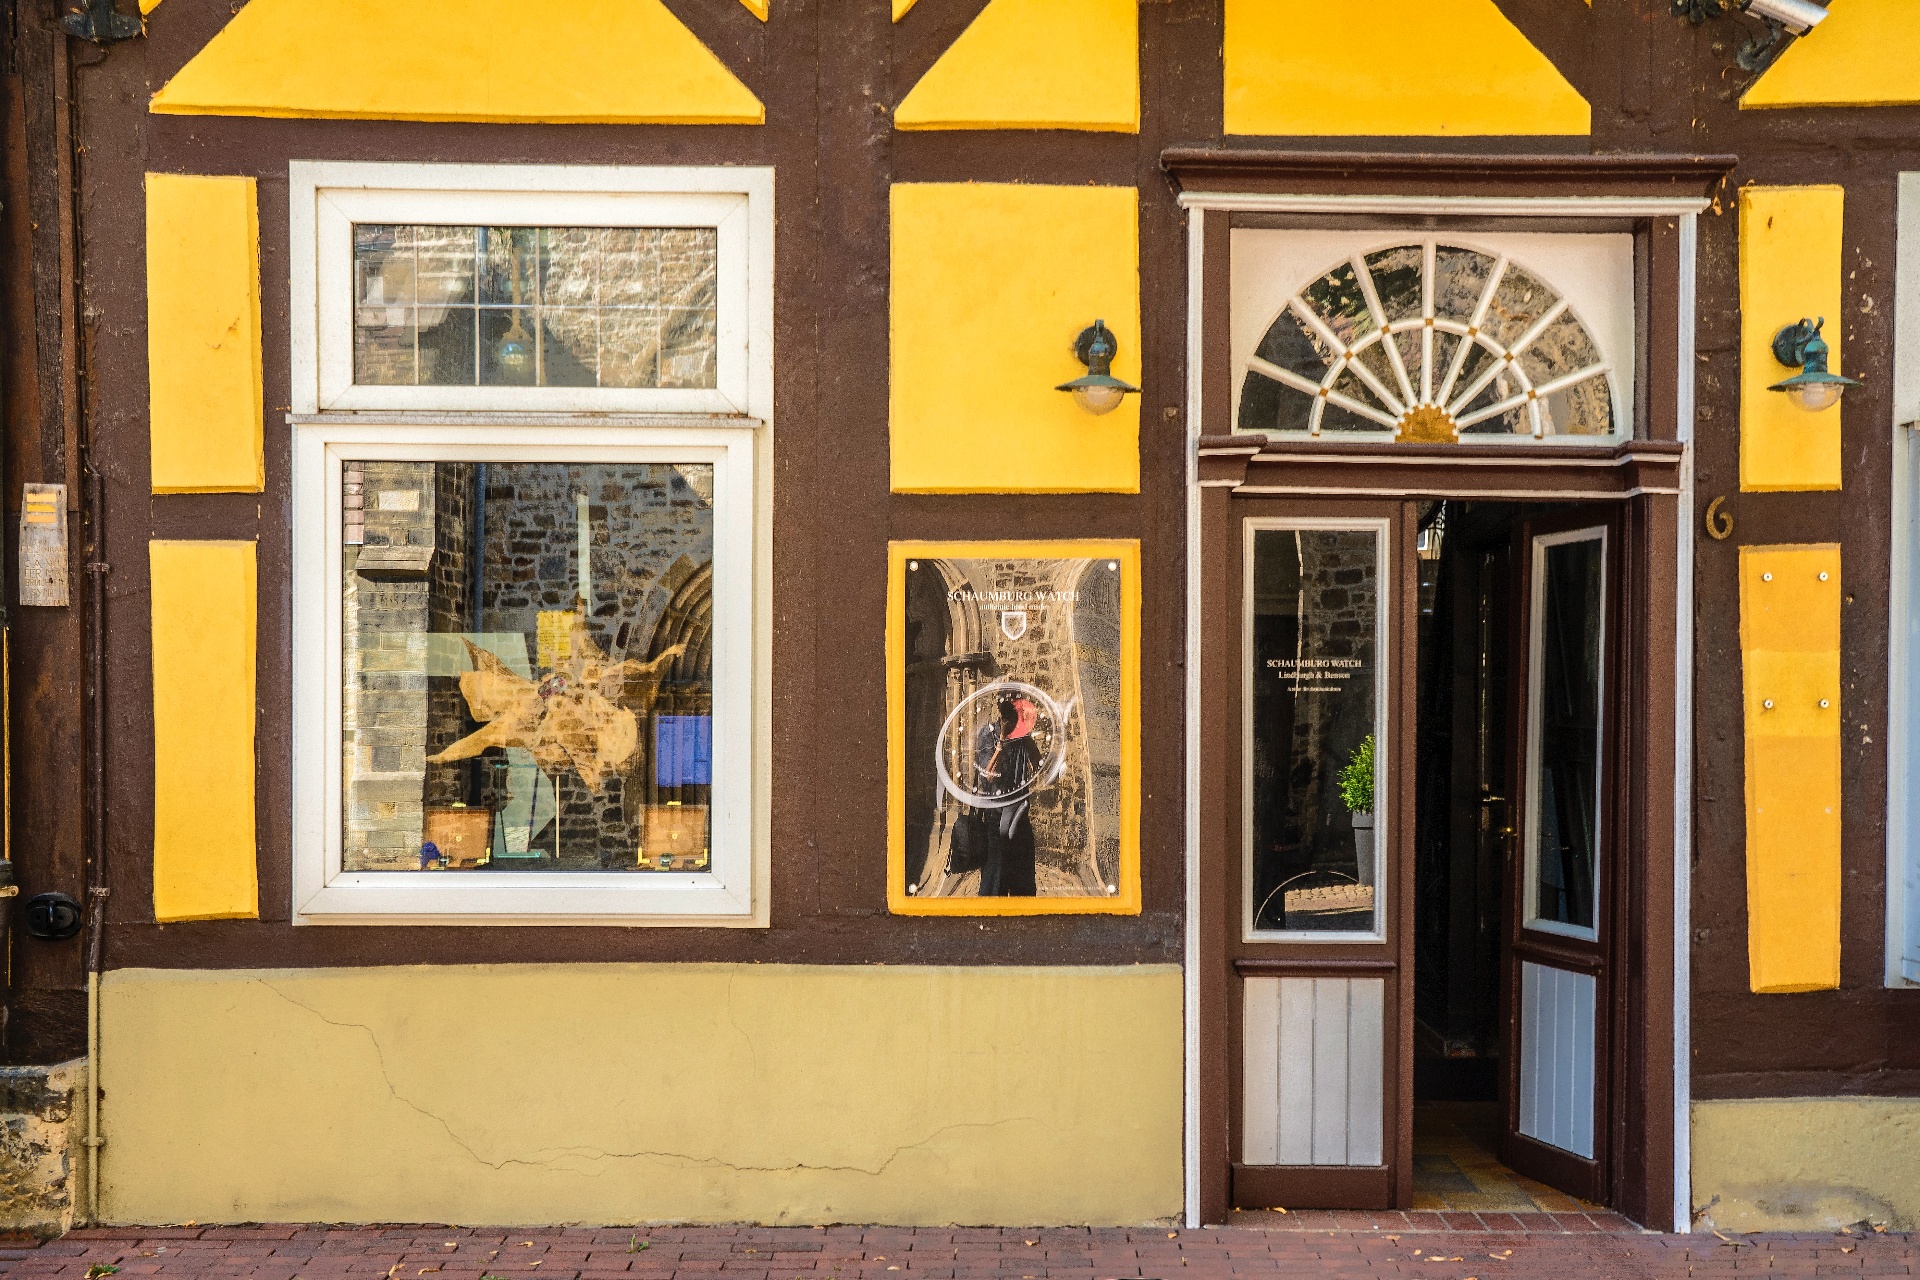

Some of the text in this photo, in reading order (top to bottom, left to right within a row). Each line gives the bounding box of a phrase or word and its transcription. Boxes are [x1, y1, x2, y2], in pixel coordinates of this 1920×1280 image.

[1706, 495, 1734, 540] 6
[947, 591, 1080, 601] SCHAUMBURG WATCH
[1330, 659, 1362, 668] WATCH
